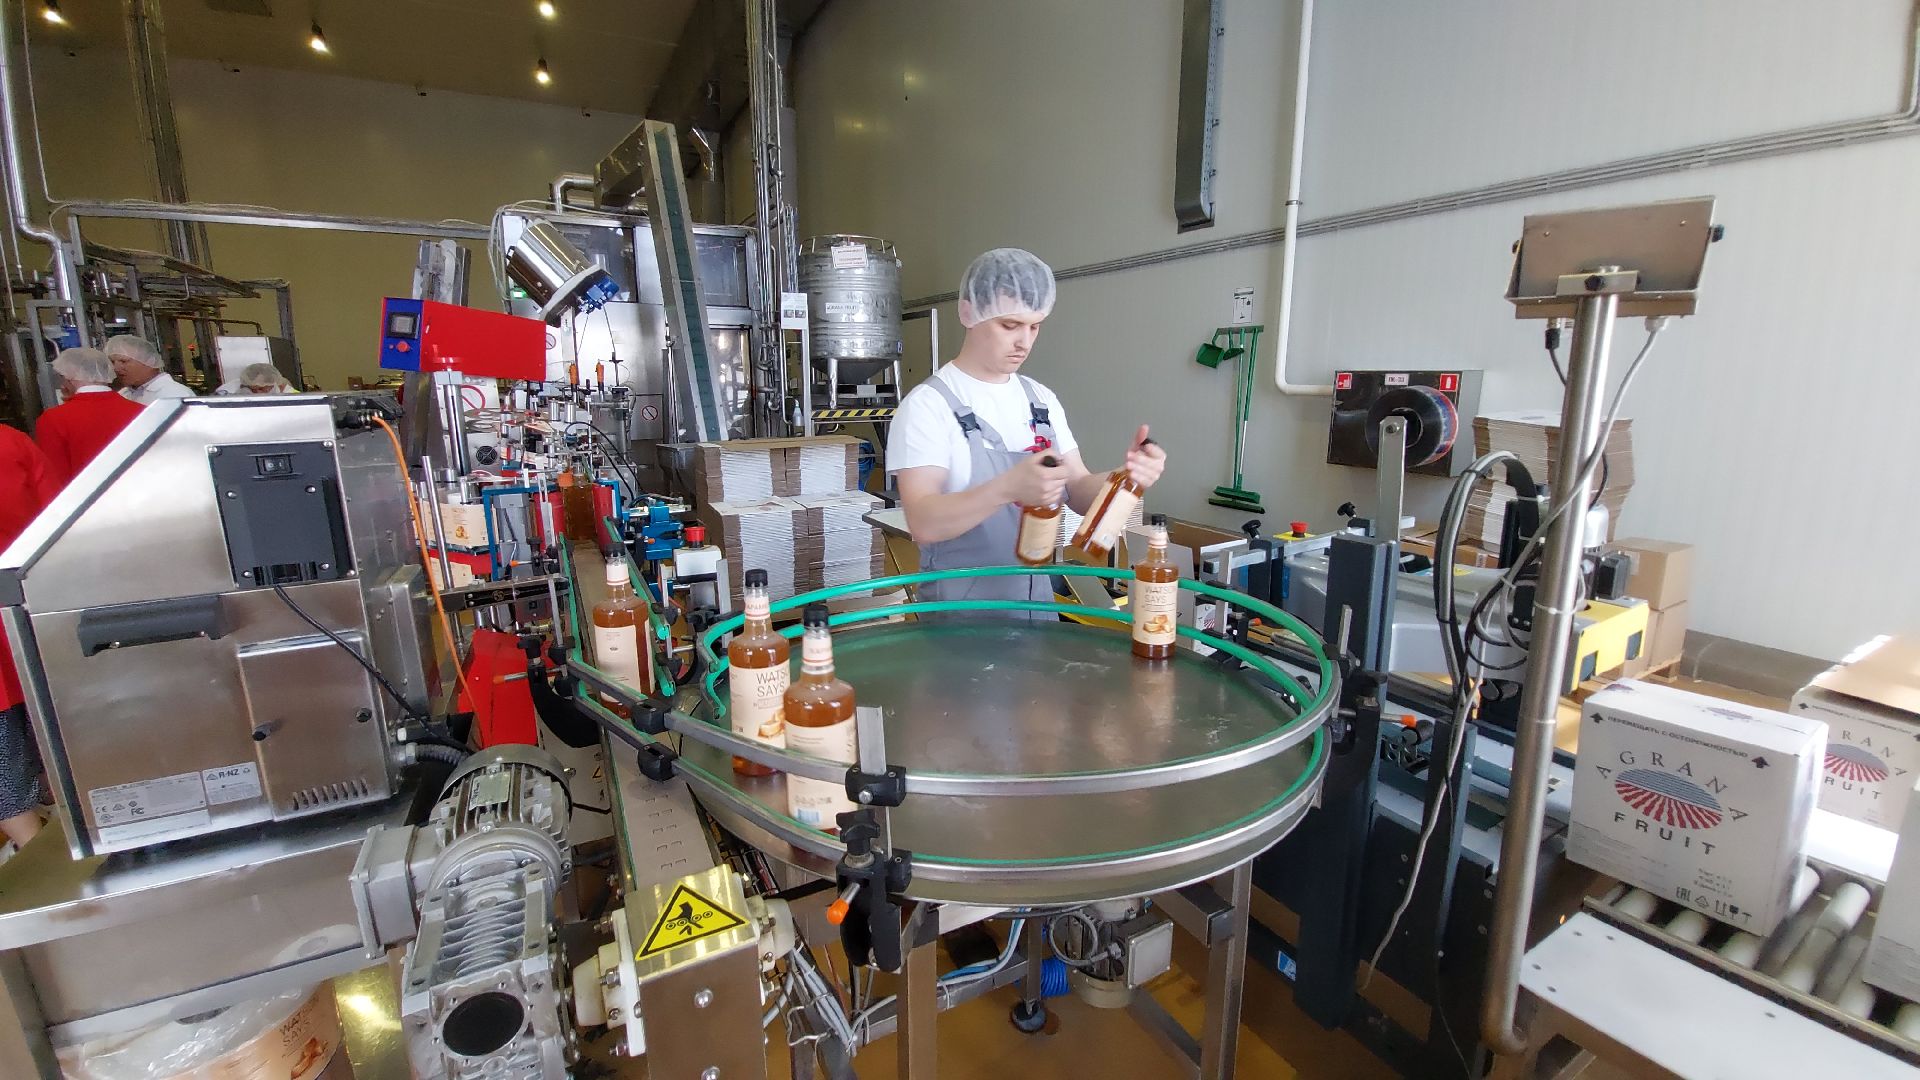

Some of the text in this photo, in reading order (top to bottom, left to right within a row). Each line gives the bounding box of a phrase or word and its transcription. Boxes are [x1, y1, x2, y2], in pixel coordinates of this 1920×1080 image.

[756, 681, 785, 698] SAYS
[1596, 750, 1749, 822] AGRANA
[1824, 776, 1882, 800] RUIT
[1614, 811, 1716, 855] FRUIT
